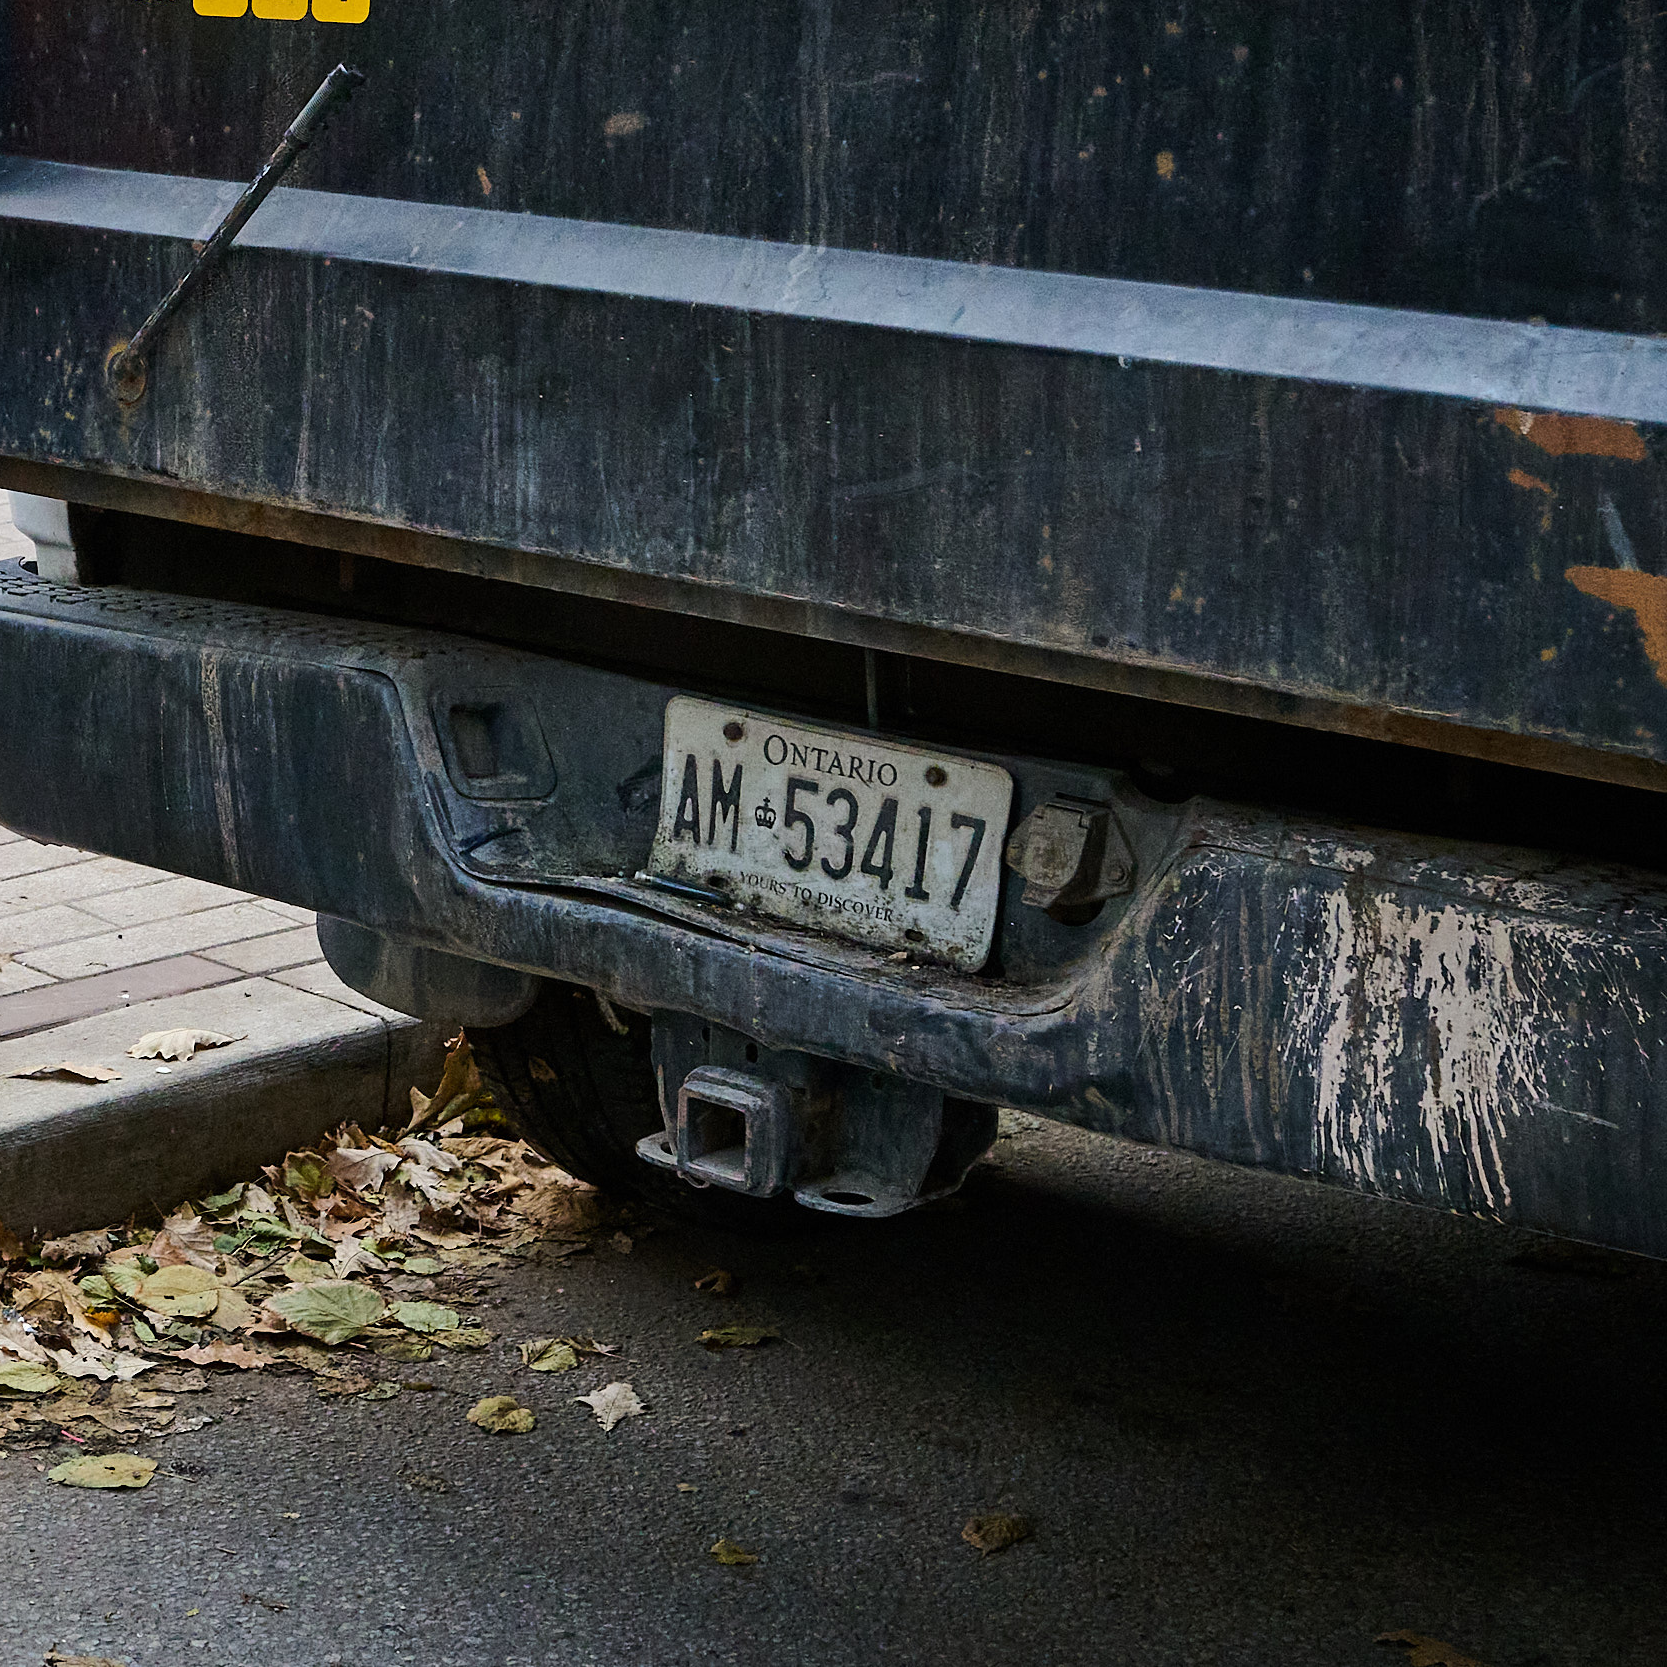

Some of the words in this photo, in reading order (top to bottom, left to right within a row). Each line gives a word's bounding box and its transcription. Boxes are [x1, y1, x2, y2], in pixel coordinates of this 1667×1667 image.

[763, 734, 898, 787] ONTARIO
[673, 753, 744, 853] AM
[783, 776, 986, 911] 53417
[739, 870, 787, 896] YOURS
[793, 885, 812, 901] TO
[817, 892, 894, 923] DISCOVER
